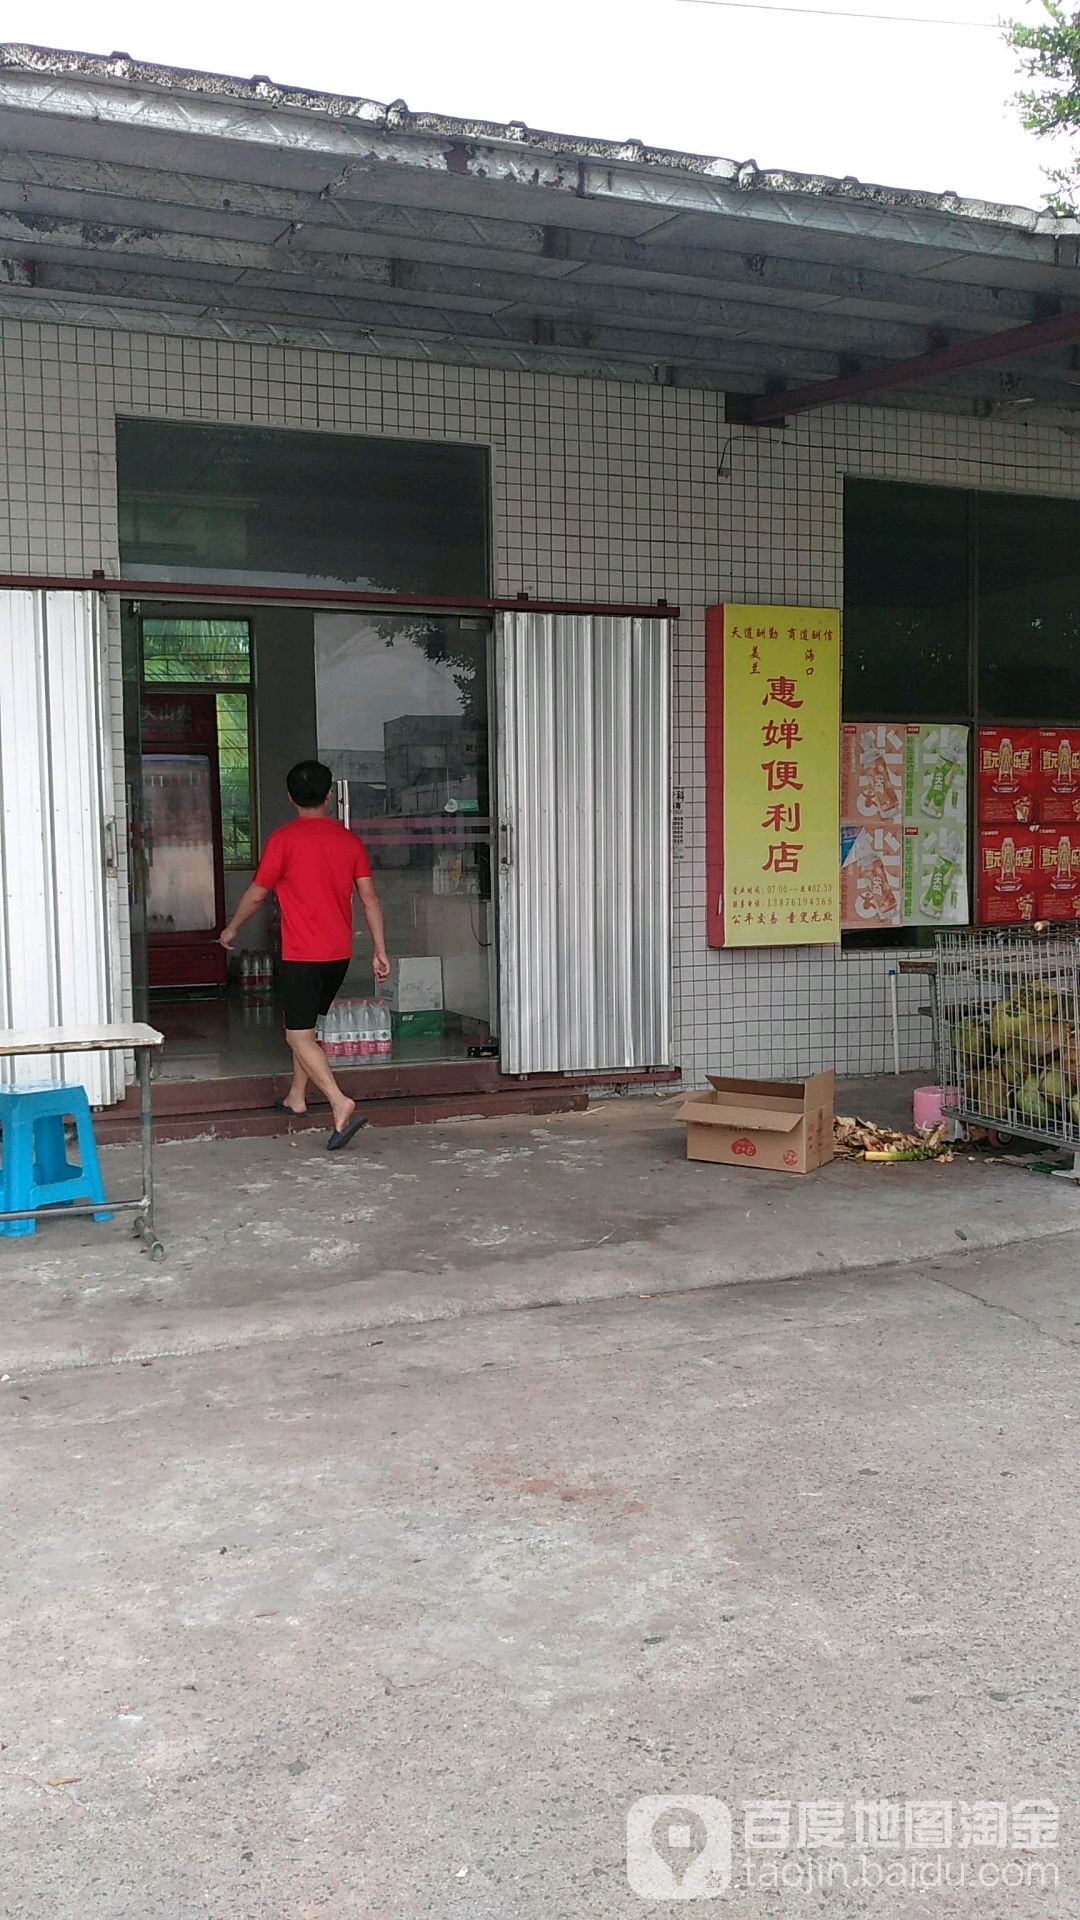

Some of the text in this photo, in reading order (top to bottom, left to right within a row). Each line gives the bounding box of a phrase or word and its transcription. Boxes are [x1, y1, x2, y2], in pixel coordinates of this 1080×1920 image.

[731, 626, 834, 641] 天道酬勤 商道酬信
[749, 645, 761, 675] 美兰
[804, 648, 816, 677] 海口
[762, 675, 804, 873] 惠婵便利店
[732, 911, 779, 925] 公平交易
